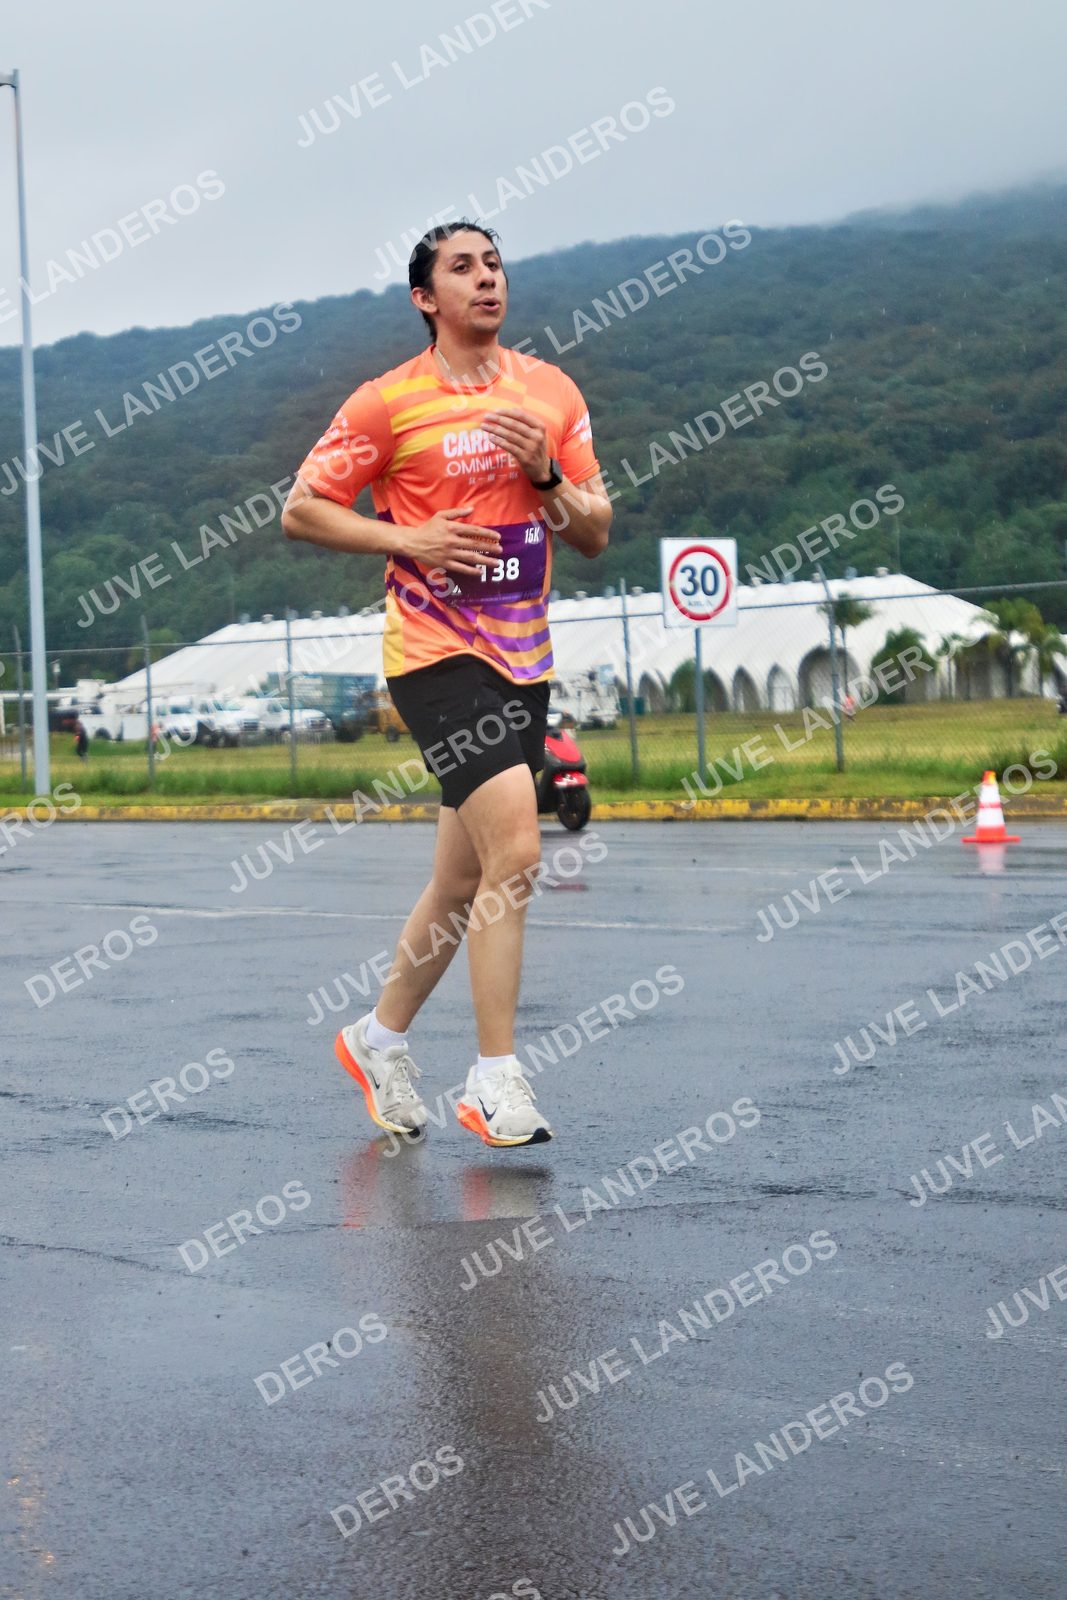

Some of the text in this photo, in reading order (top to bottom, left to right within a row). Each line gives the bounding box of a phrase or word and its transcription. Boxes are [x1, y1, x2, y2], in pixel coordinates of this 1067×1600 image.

[446, 453, 517, 476] OMNILIFE
[525, 526, 541, 544] 15K
[680, 565, 719, 597] 30
